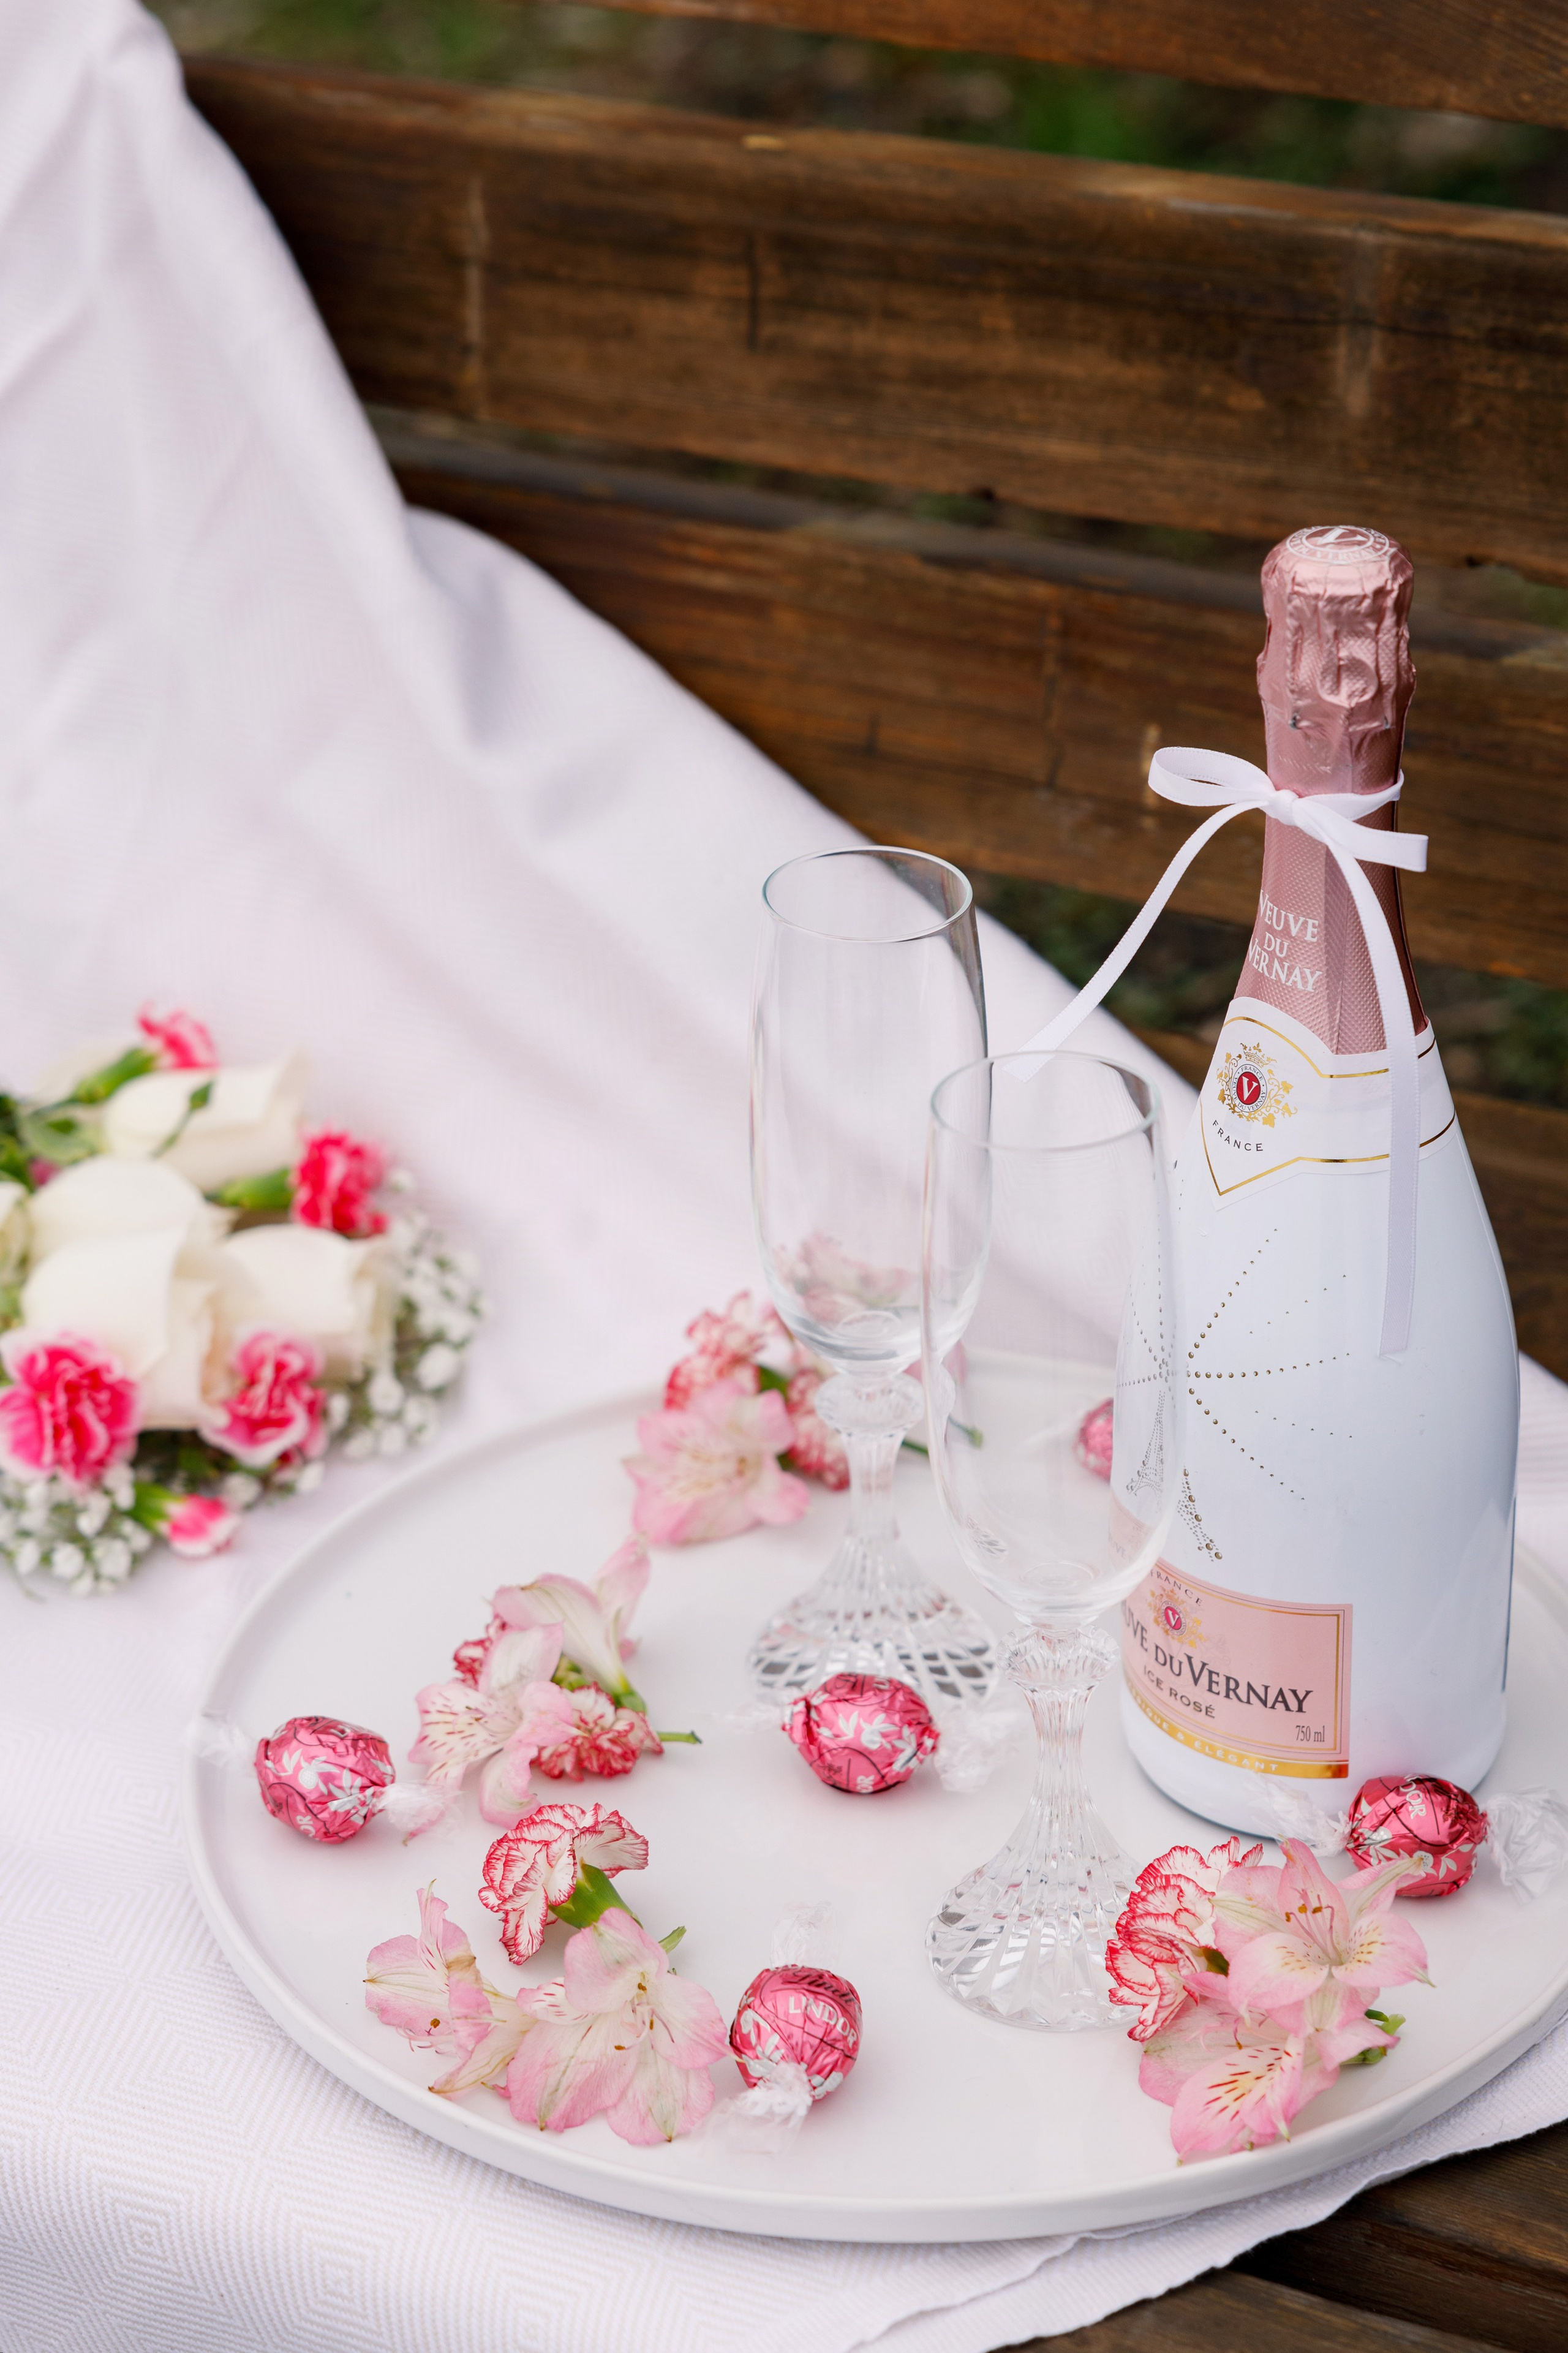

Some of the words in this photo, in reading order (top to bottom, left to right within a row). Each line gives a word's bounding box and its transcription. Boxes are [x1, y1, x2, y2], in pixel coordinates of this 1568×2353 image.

[1259, 889, 1319, 943] VEUVE
[1263, 931, 1289, 958] DU
[1248, 933, 1323, 992] VERNAY
[1240, 1065, 1264, 1081] FRANCE
[1242, 1076, 1259, 1101] V
[1237, 1102, 1247, 1111] DU
[1247, 1090, 1266, 1111] VERNAY
[1212, 1119, 1264, 1152] FRANCE
[1121, 1600, 1148, 1652] UVE
[1167, 1609, 1180, 1627] V
[1144, 1664, 1164, 1691] ICE
[1169, 1686, 1216, 1719] ROSÉ
[1295, 1724, 1311, 1742] 750
[1313, 1724, 1325, 1742] ml
[1194, 1740, 1279, 1771] ÉLÉGANT
[788, 1995, 858, 2049] LINDOR
